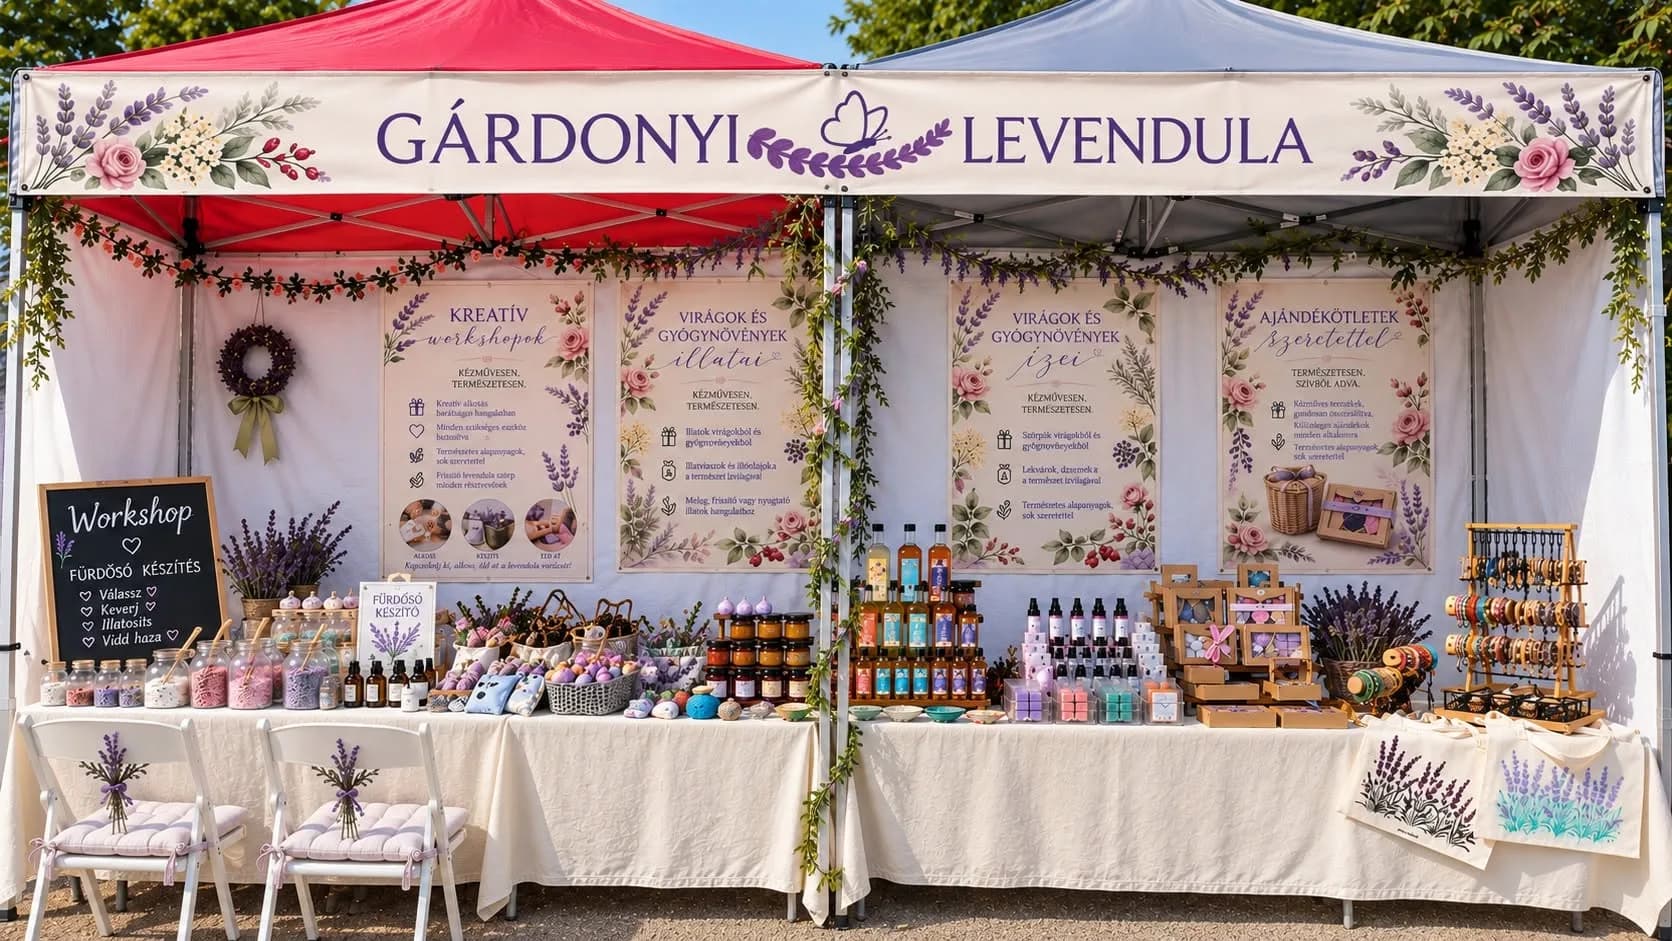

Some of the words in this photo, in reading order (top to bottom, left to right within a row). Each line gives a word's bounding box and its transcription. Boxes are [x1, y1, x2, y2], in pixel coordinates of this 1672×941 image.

[376, 98, 740, 165] GÁRDONYI
[963, 116, 1314, 165] LEVENDULA
[450, 305, 528, 323] KREATÍV
[680, 309, 747, 324] VIRÁGOK
[751, 309, 768, 324] ÉS
[1013, 310, 1081, 325] VIRÁGOK
[1085, 310, 1101, 325] ÉS
[1260, 308, 1399, 325] AJÁNDÉKÖTLETEK
[424, 325, 552, 352] workshopok
[658, 328, 788, 342] GYÓGYNÖVÉNYEK
[991, 329, 1120, 343] GYÓGYNÖVÉNYEK
[1256, 327, 1392, 357] szeretettel
[670, 345, 768, 370] illatai
[67, 495, 194, 535] Workshop
[142, 558, 201, 577] KÉSZÍTÉS
[99, 588, 142, 600] Válassz
[101, 602, 139, 617] Keverj
[102, 633, 130, 646] Vidd
[134, 631, 162, 644] haza
